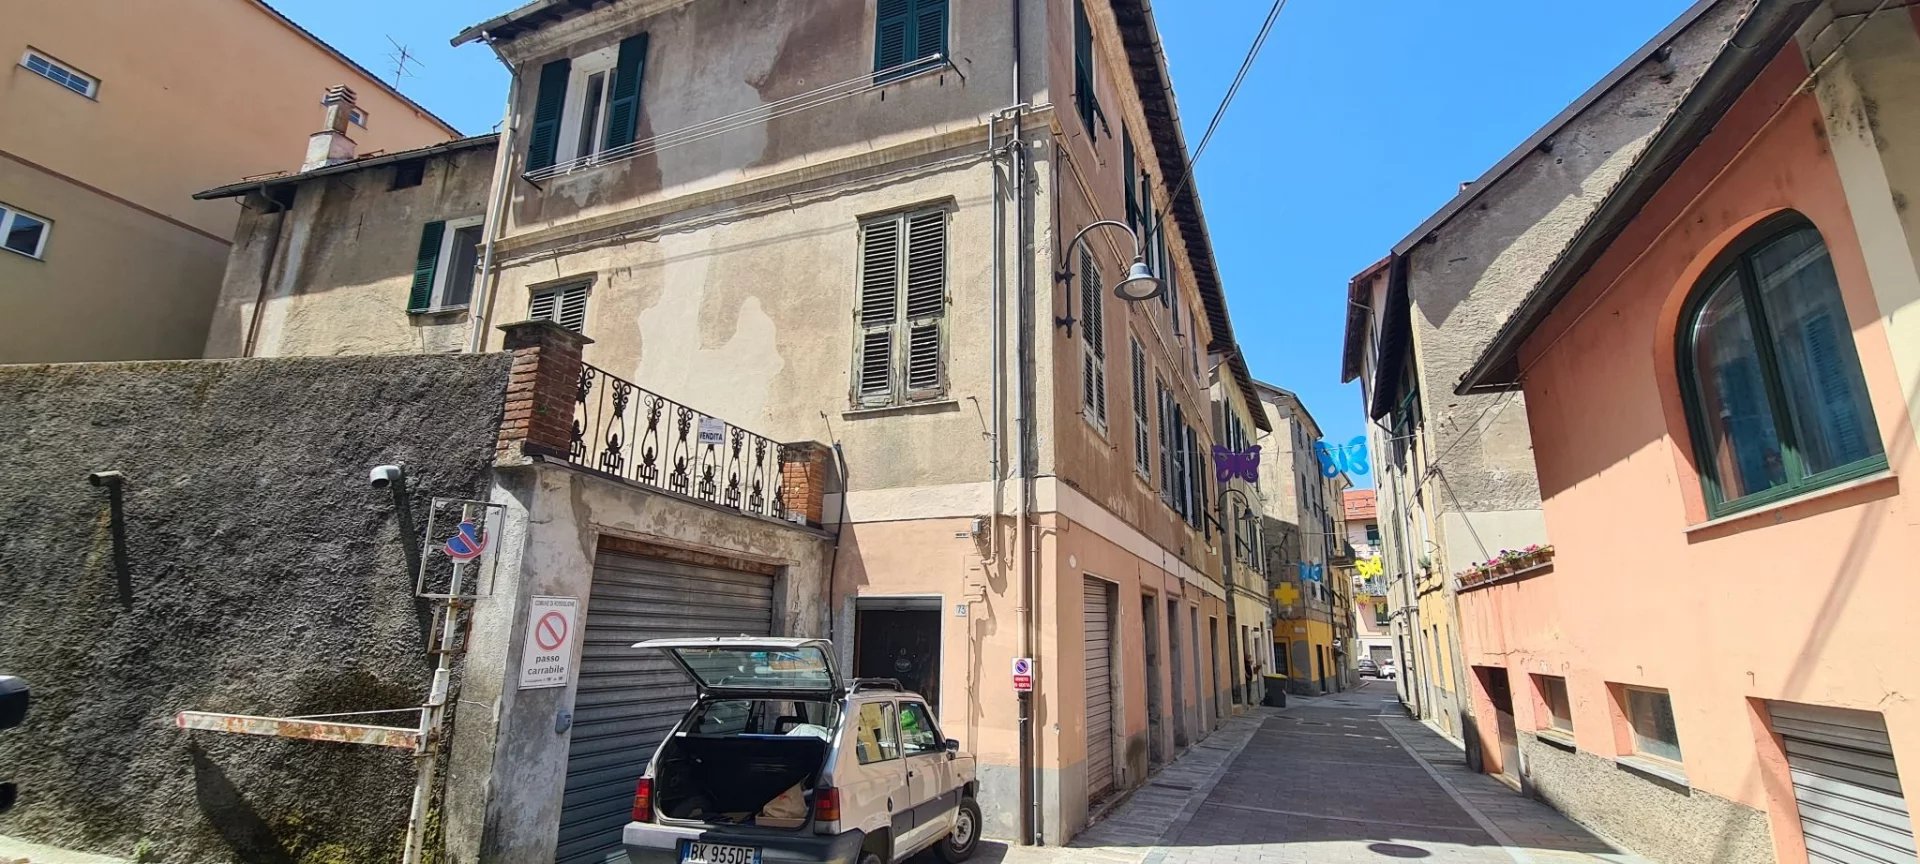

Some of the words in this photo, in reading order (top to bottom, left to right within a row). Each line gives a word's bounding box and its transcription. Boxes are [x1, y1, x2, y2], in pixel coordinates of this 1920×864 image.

[699, 431, 723, 441] VENDITA
[535, 655, 560, 664] passo
[527, 665, 565, 676] carrabile
[691, 843, 708, 862] BK
[711, 846, 754, 864] 955DE
